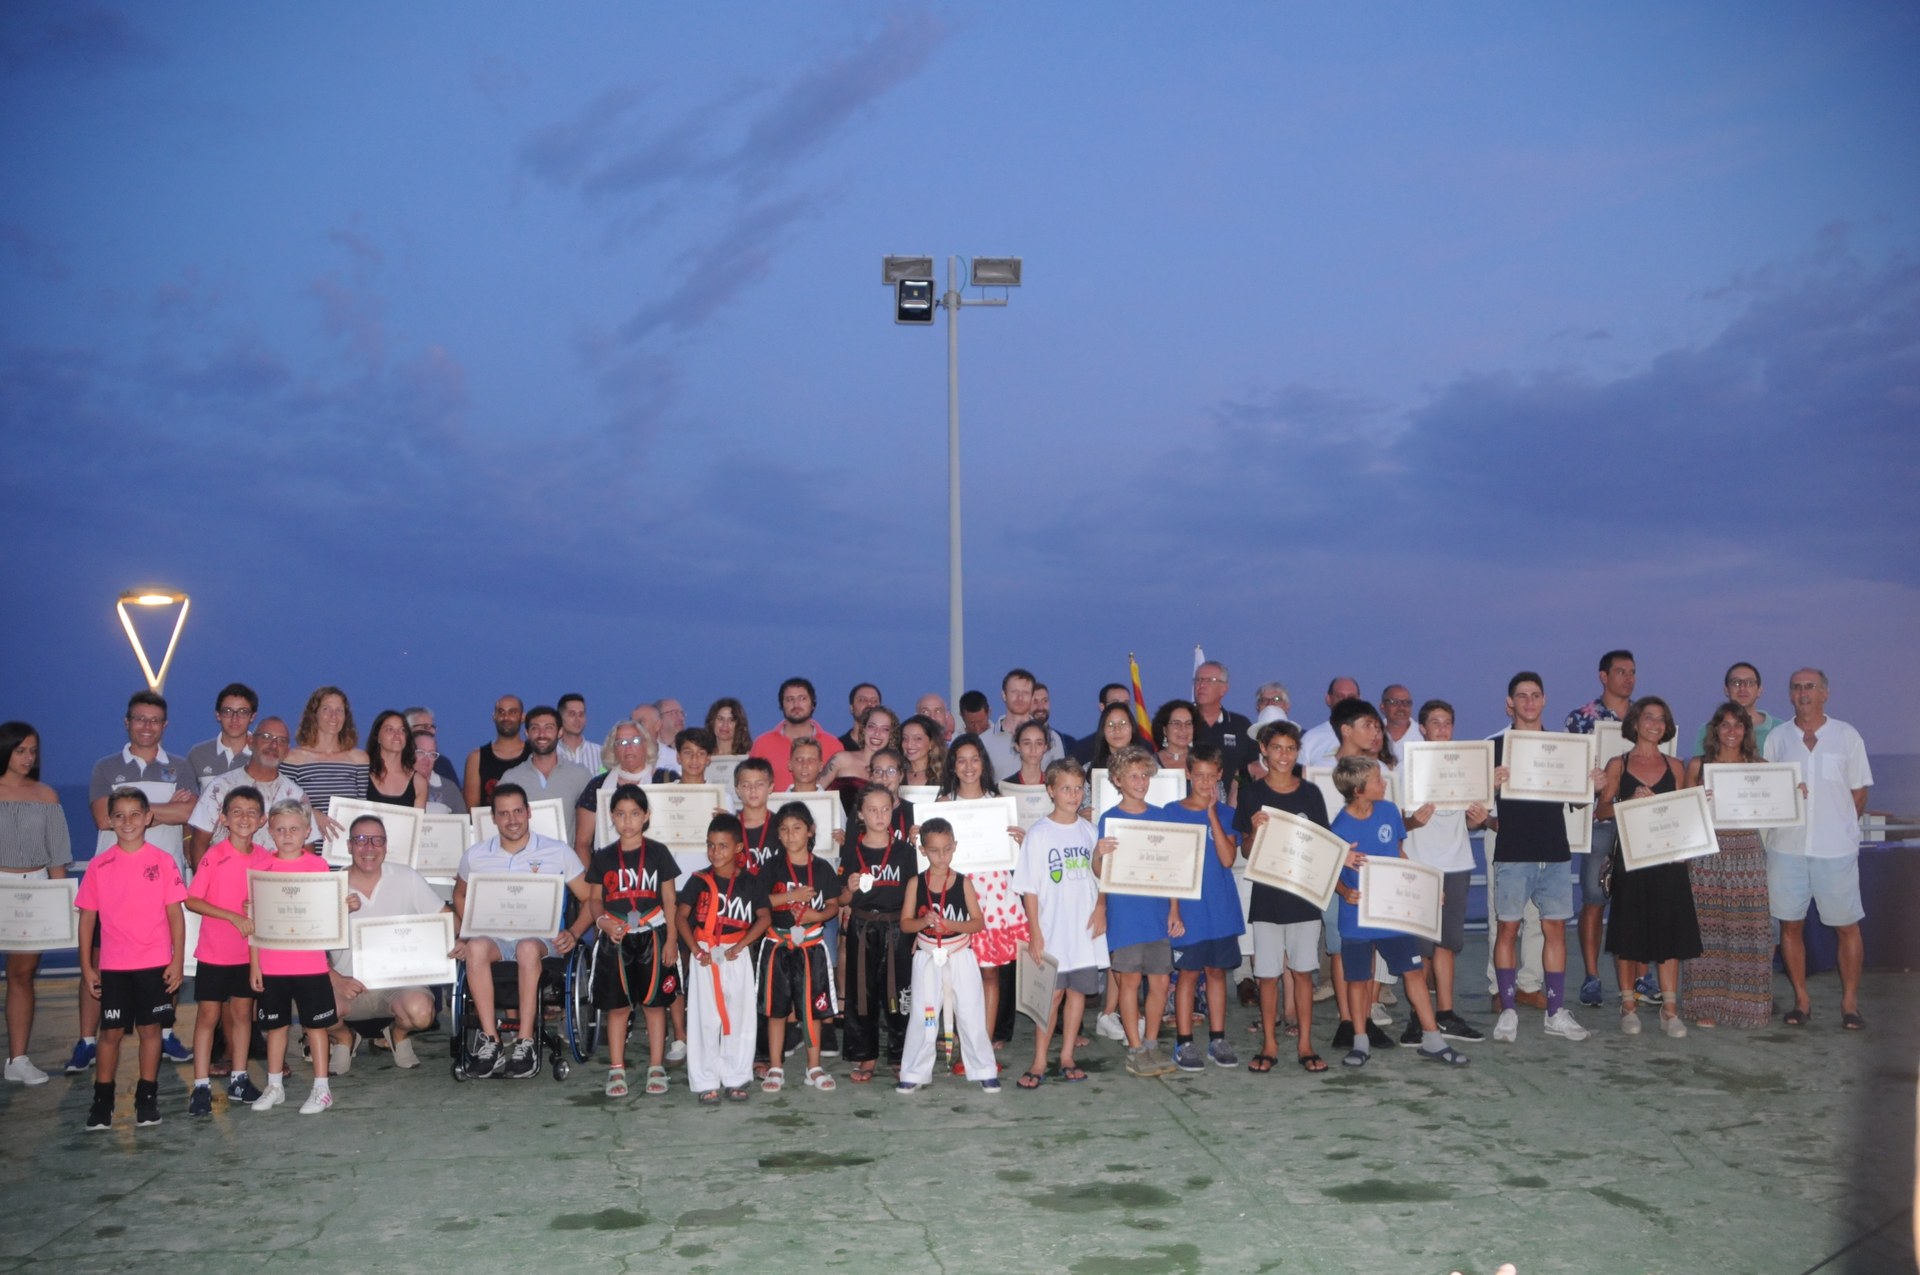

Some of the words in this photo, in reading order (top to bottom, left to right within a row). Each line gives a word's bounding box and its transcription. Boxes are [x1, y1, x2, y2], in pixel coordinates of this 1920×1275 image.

[1065, 858, 1089, 869] SKA
[618, 868, 658, 892] DYM
[871, 864, 901, 881] DYM
[1067, 869, 1088, 880] CLU
[717, 892, 752, 924] DYM
